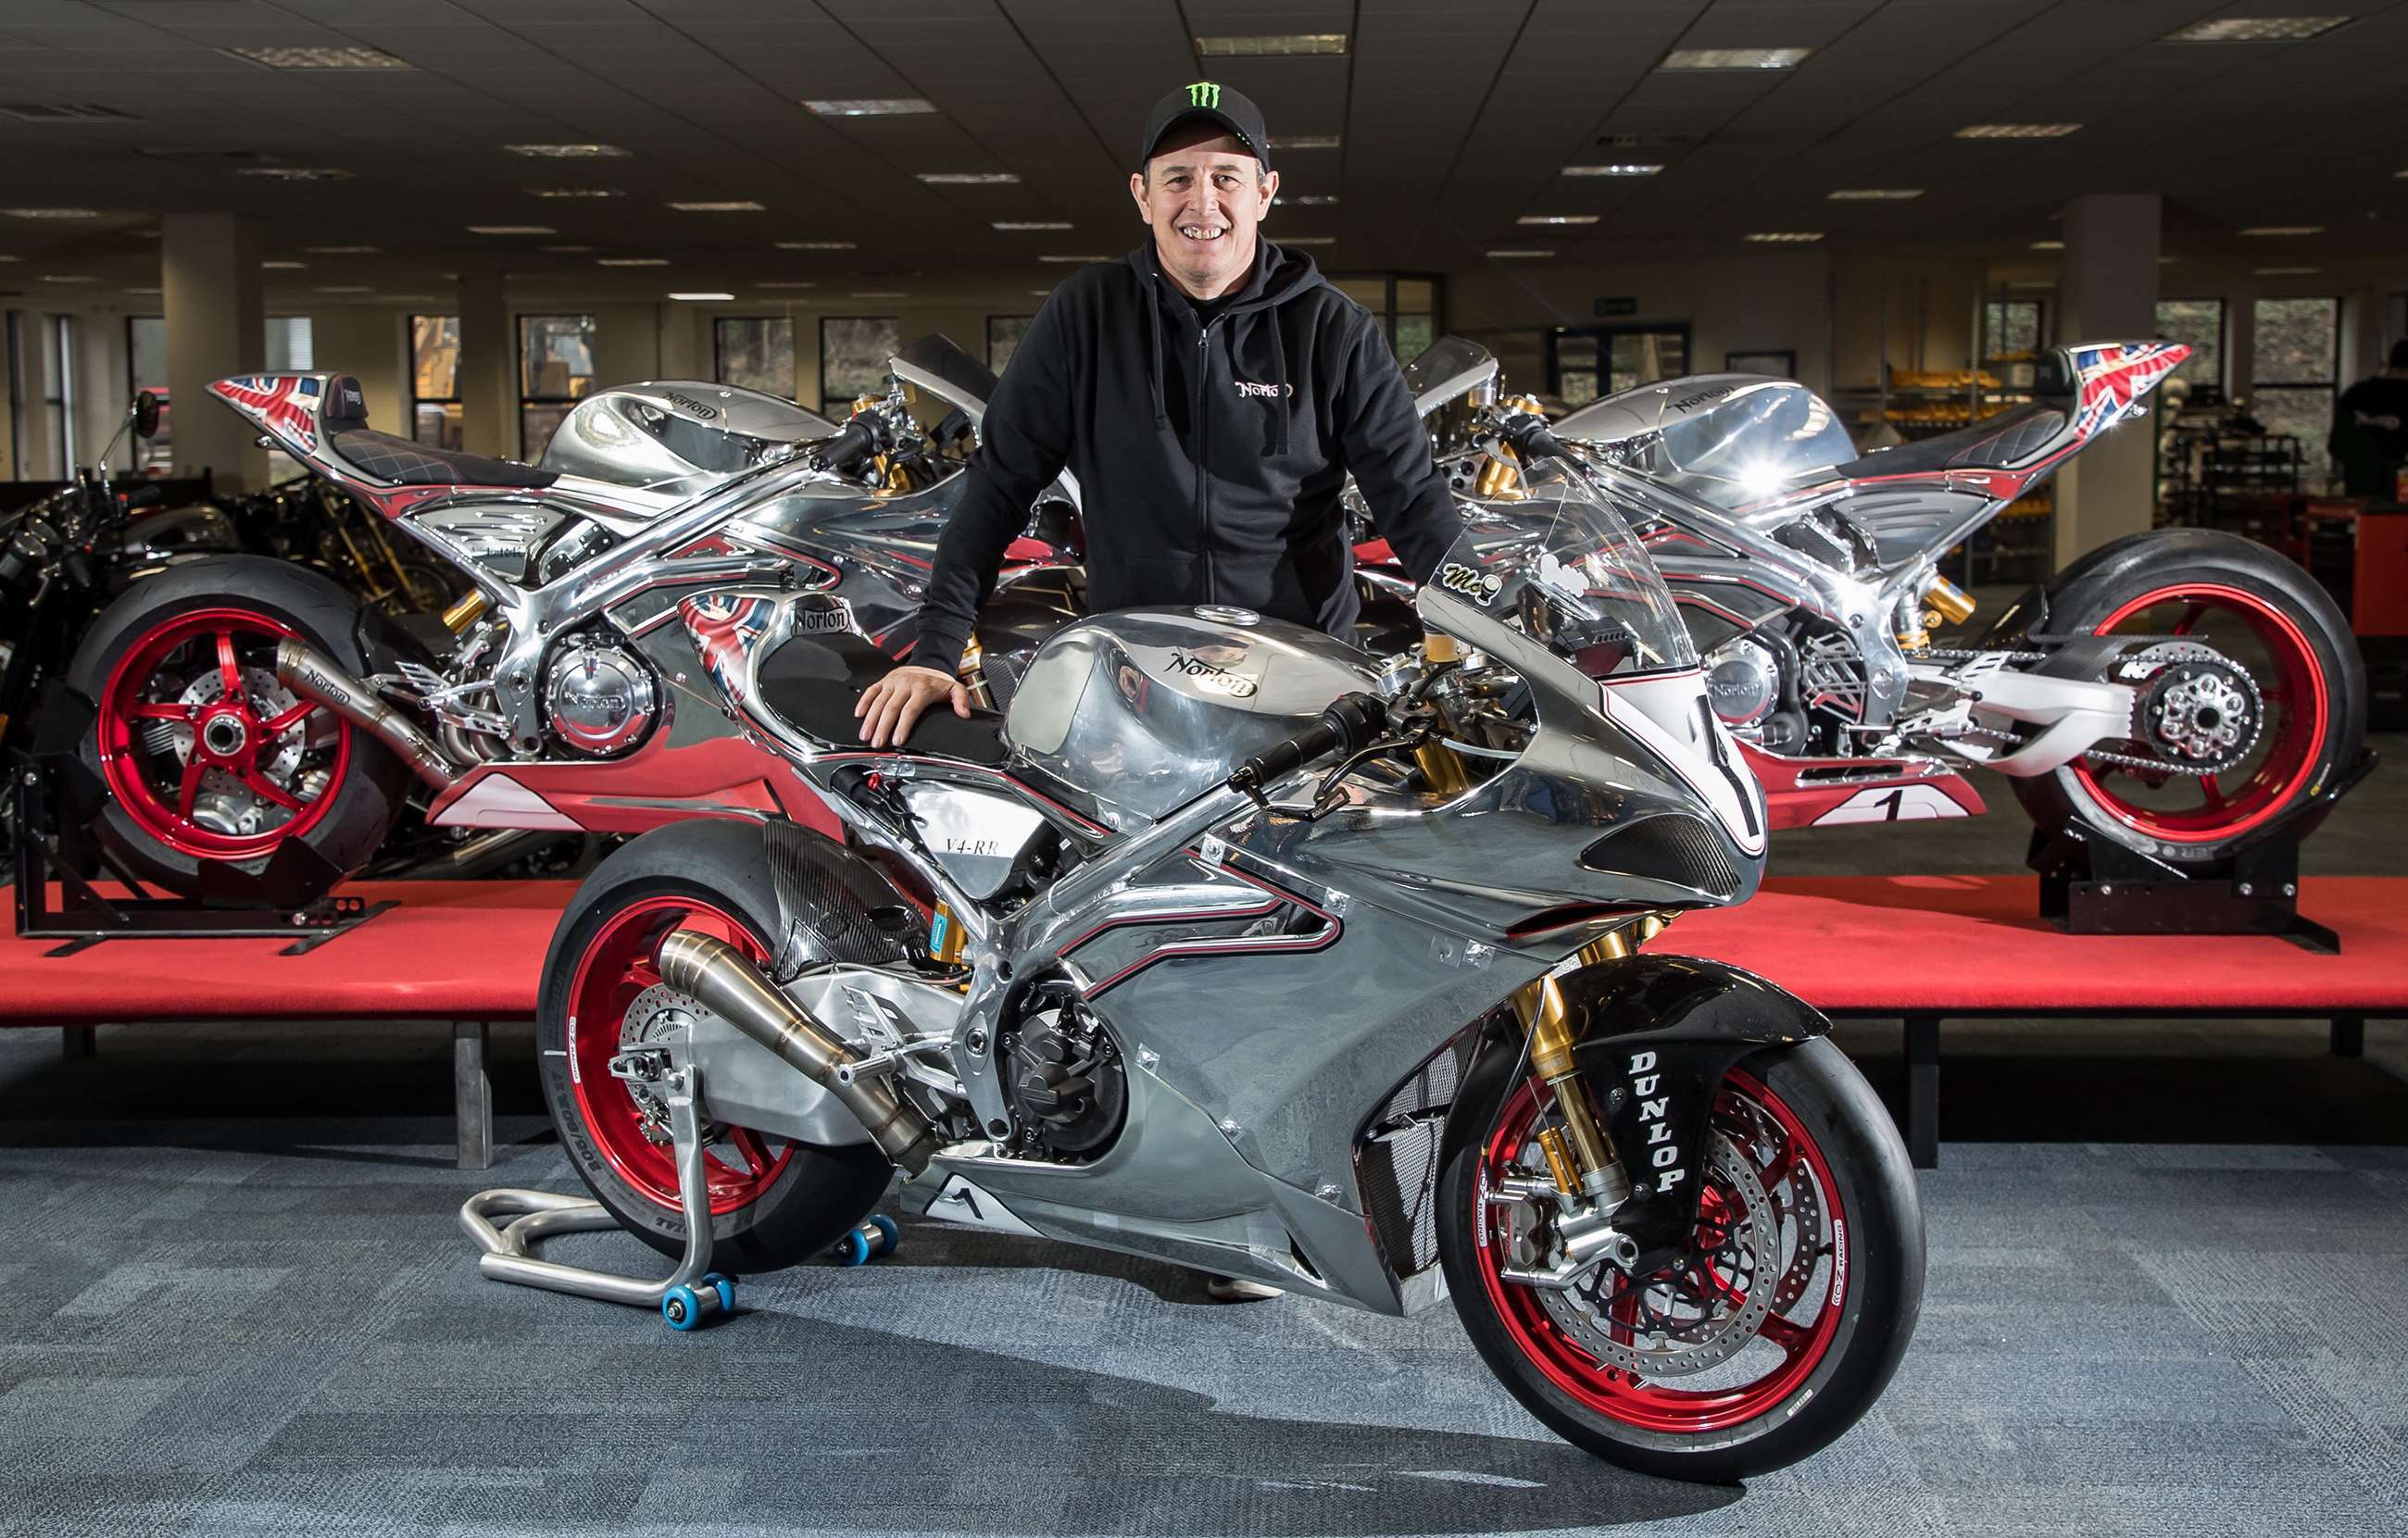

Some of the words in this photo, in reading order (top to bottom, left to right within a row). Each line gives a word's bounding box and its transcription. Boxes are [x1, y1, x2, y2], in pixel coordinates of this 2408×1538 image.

[662, 391, 718, 419] Norton
[1235, 381, 1293, 398] Norto
[791, 606, 851, 635] Norton
[305, 669, 351, 706] Norton
[1873, 790, 1903, 822] 1
[1628, 1050, 1686, 1194] DUNLOP
[951, 1187, 985, 1220] 1
